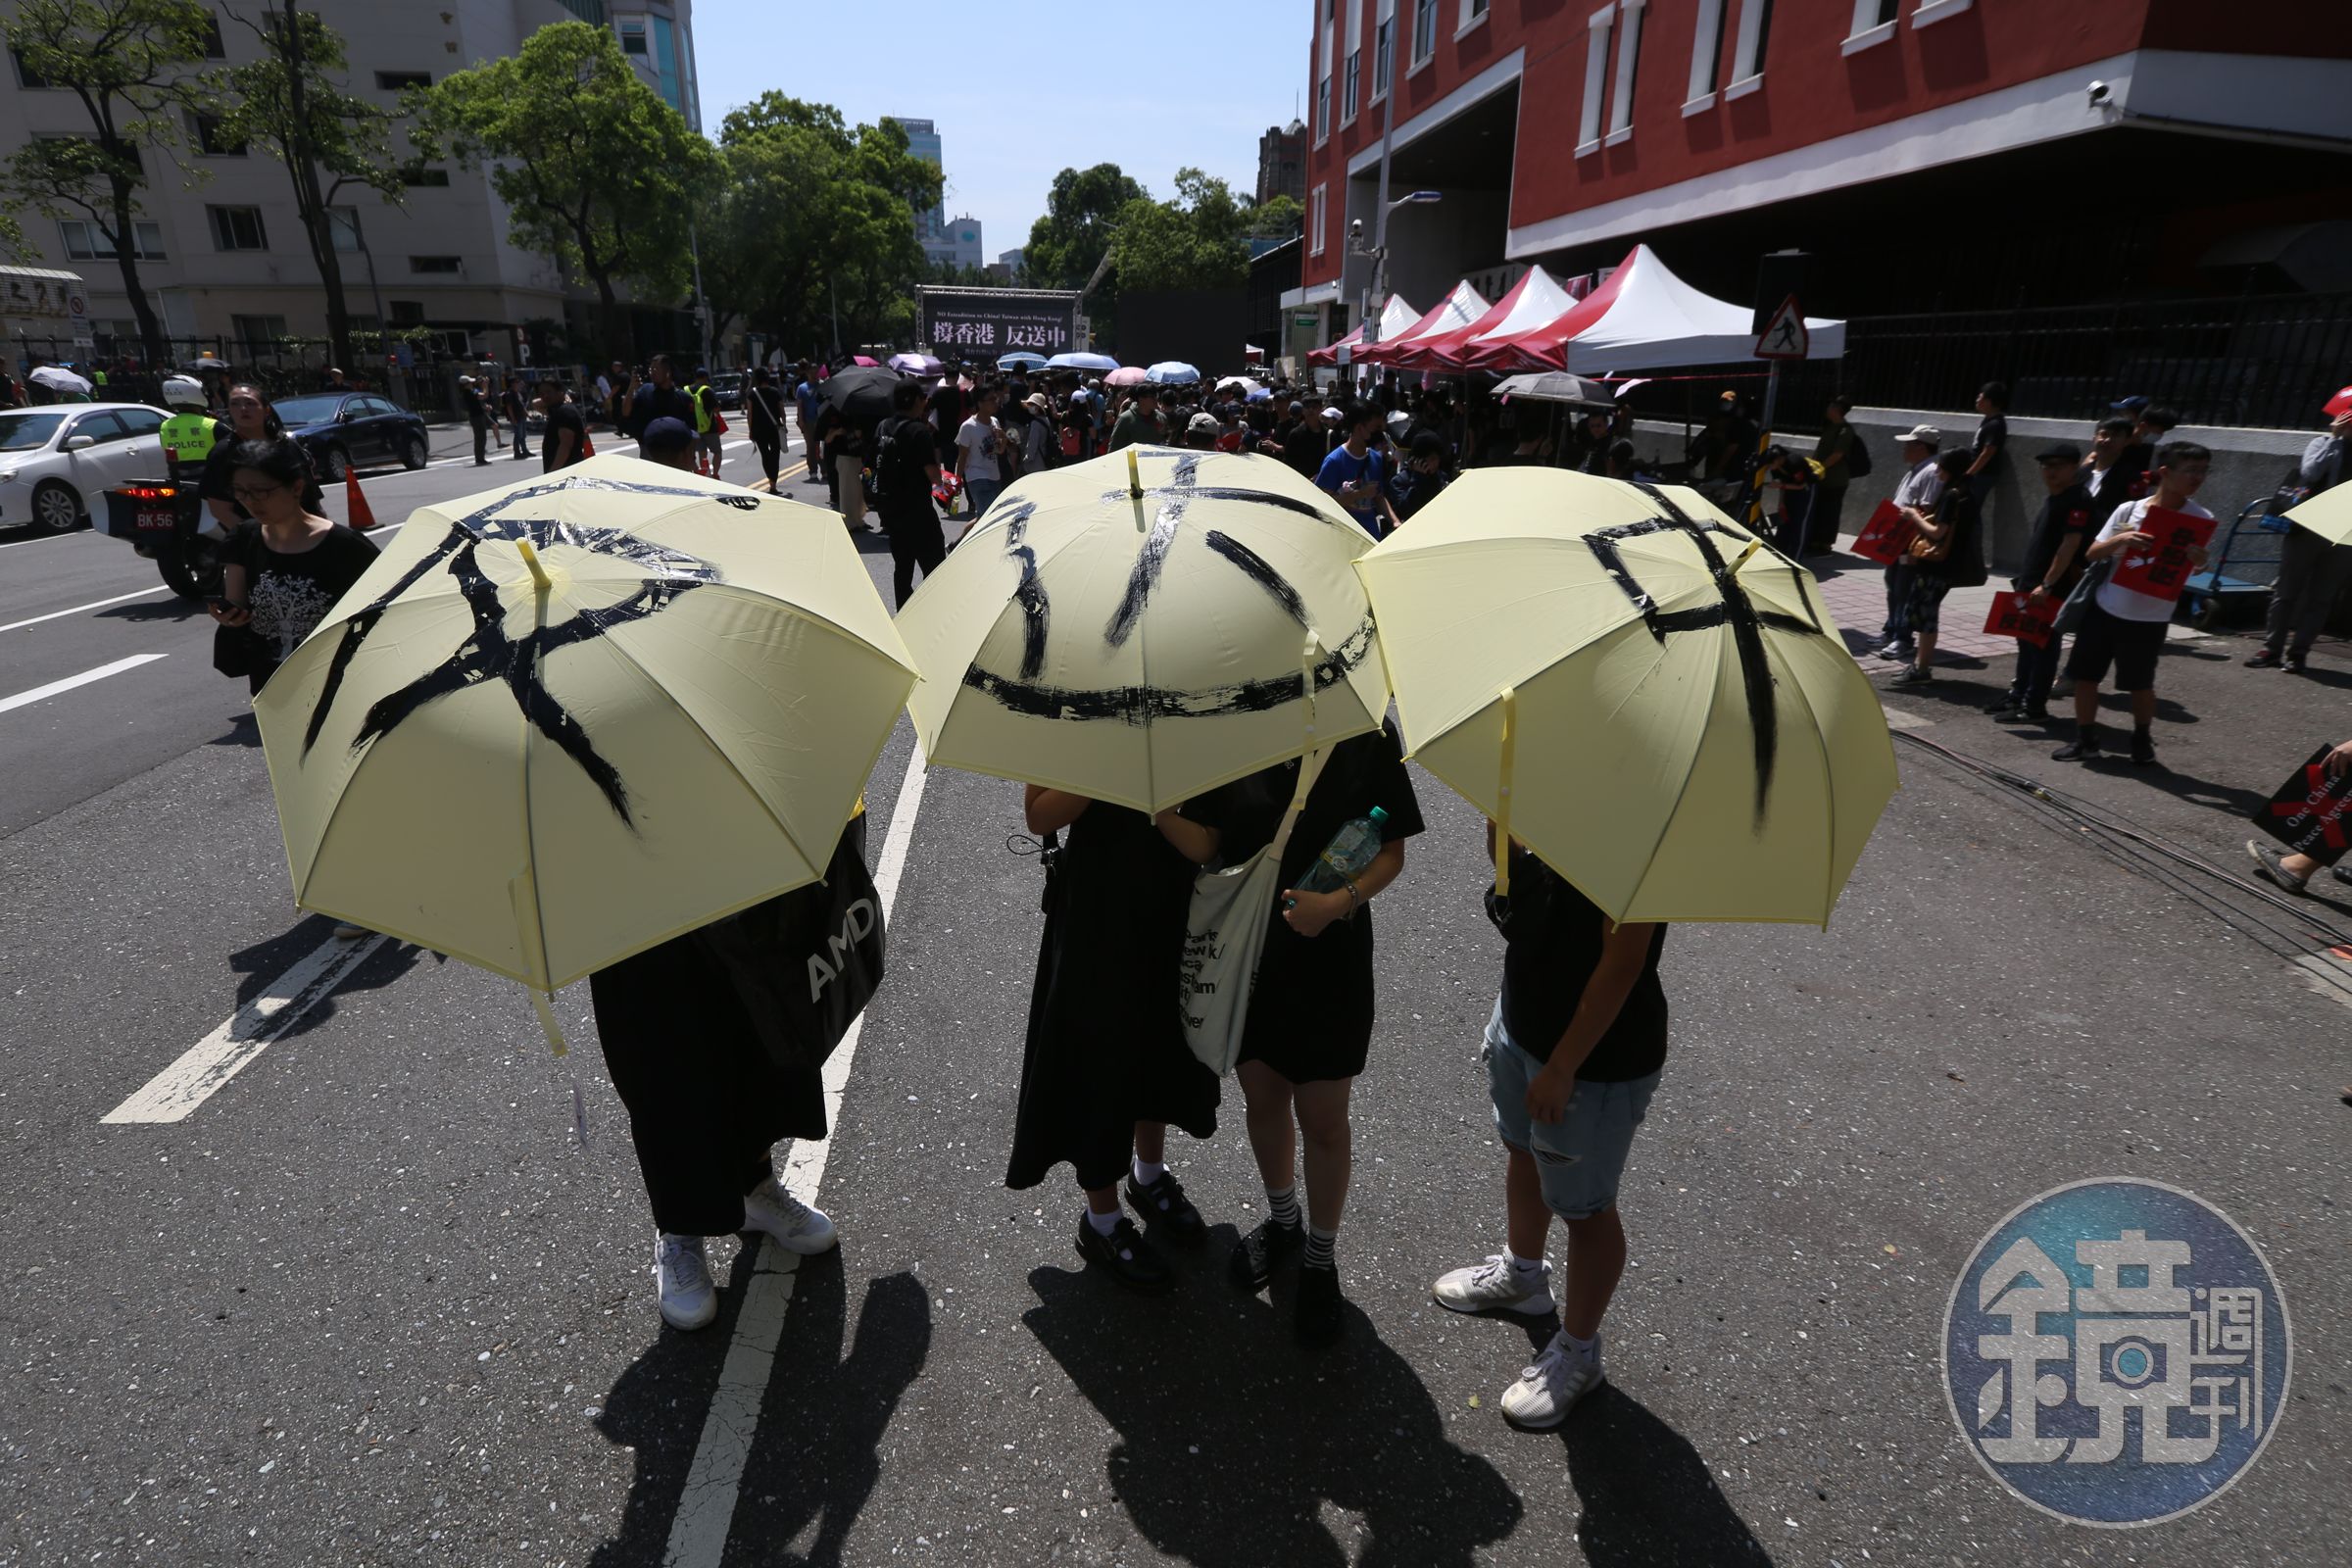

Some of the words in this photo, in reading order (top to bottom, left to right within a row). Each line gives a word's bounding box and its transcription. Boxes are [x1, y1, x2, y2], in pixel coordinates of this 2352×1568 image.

[1005, 324, 1066, 348] 反送中
[168, 440, 205, 449] POLICE
[1581, 481, 1825, 838] 中
[2286, 807, 2311, 827] One
[2306, 775, 2340, 806] China
[2292, 824, 2325, 852] Peace
[807, 898, 875, 1004] AMD
